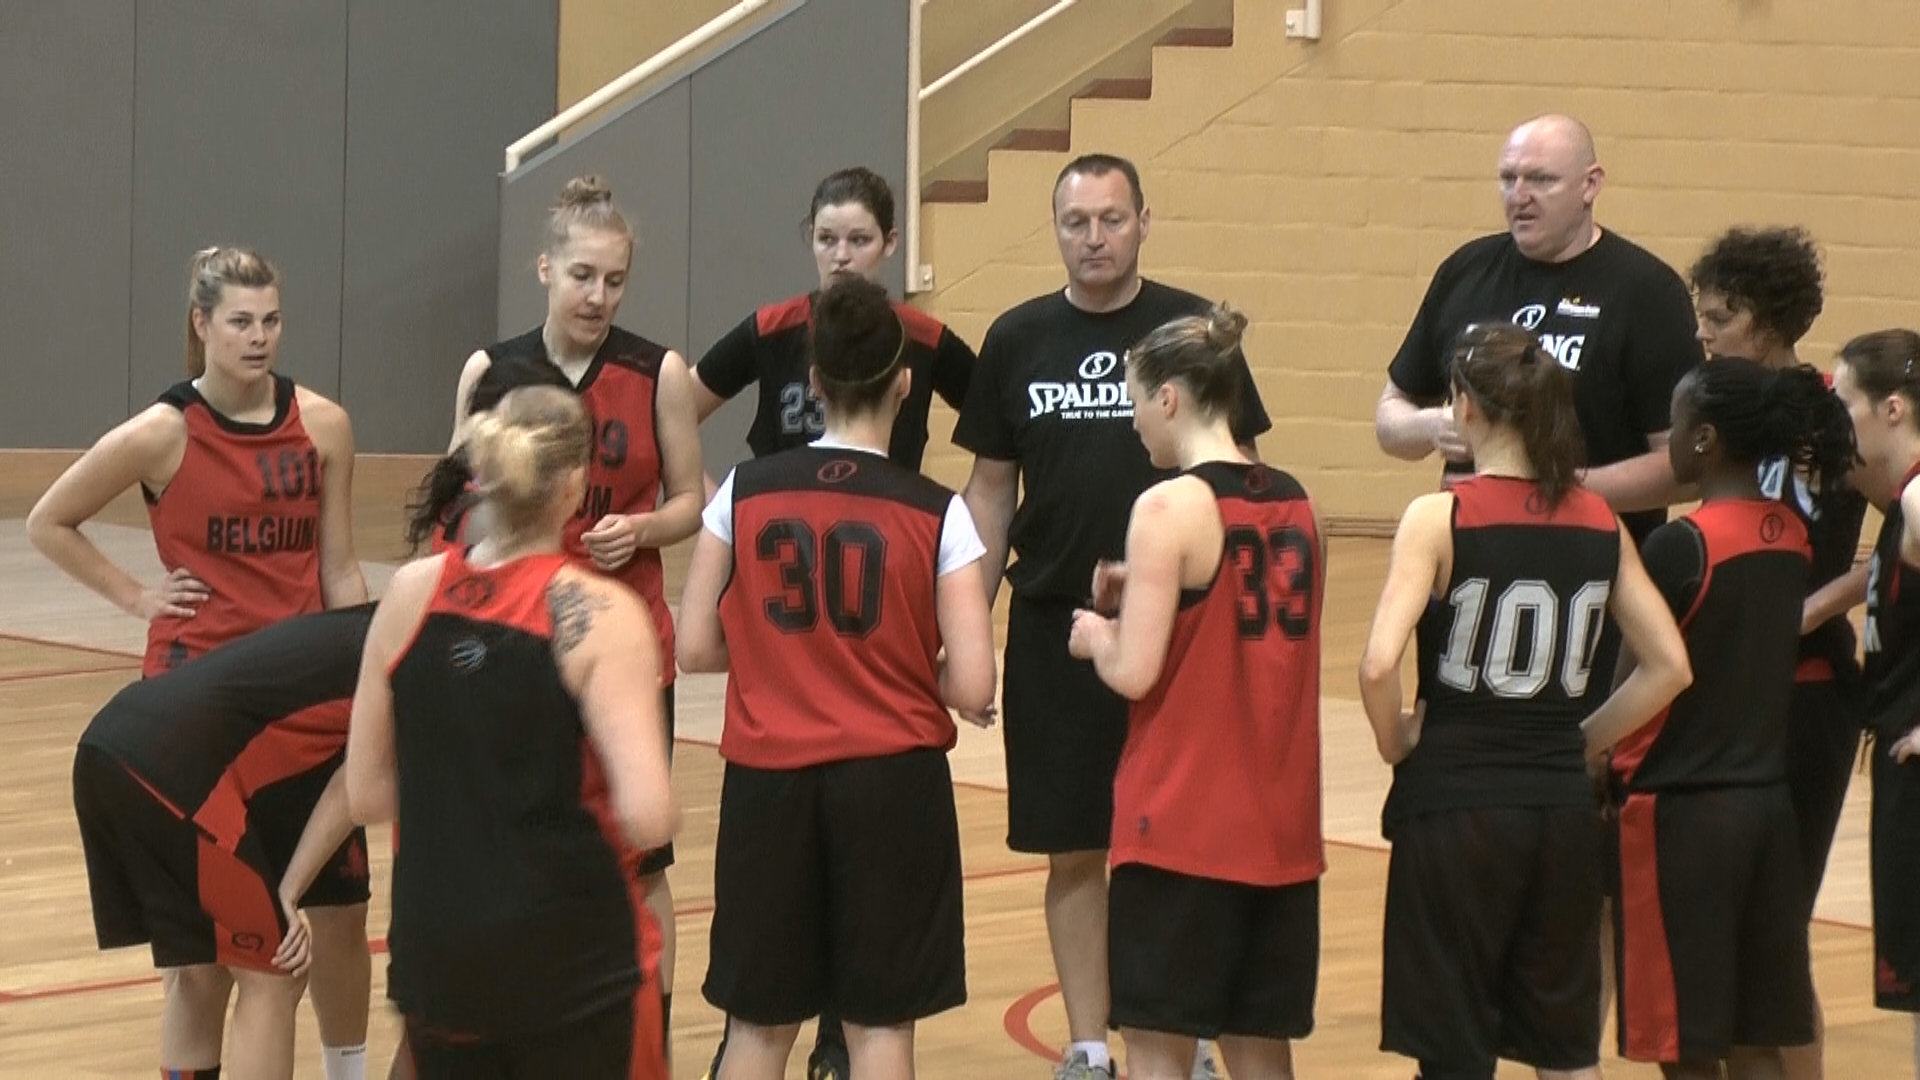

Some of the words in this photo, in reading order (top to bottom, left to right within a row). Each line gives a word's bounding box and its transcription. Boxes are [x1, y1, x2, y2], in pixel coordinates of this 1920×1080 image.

[1061, 410, 1082, 419] TRUE
[1083, 410, 1094, 419] TO
[1096, 410, 1111, 419] THE
[755, 517, 887, 640] 30
[1225, 522, 1315, 642] 33
